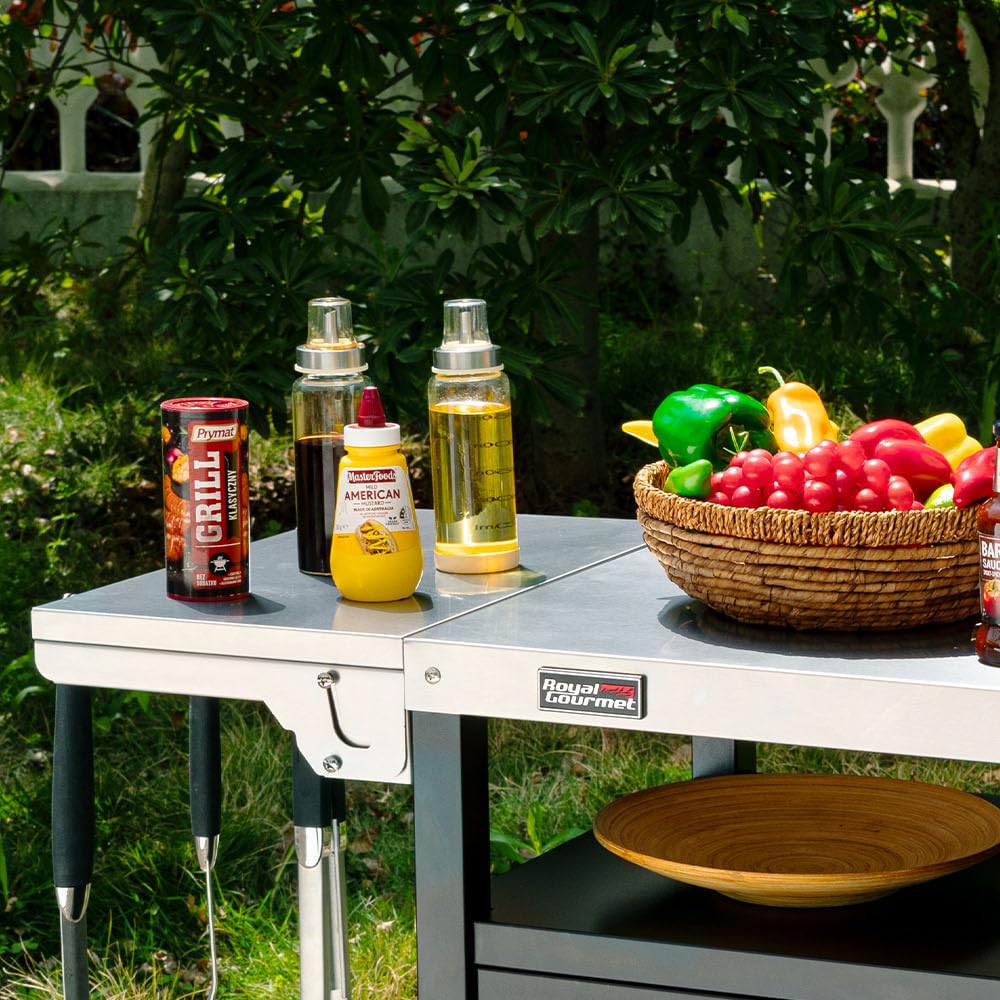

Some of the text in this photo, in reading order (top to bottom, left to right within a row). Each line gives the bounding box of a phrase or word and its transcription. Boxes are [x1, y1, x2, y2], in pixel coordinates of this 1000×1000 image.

[196, 427, 235, 442] Prymat
[193, 450, 222, 543] GRILL
[228, 470, 238, 521] KLASYCZNY
[345, 489, 401, 501] AMERICAN
[542, 678, 600, 695] Royal
[545, 691, 637, 711] Gourmet
